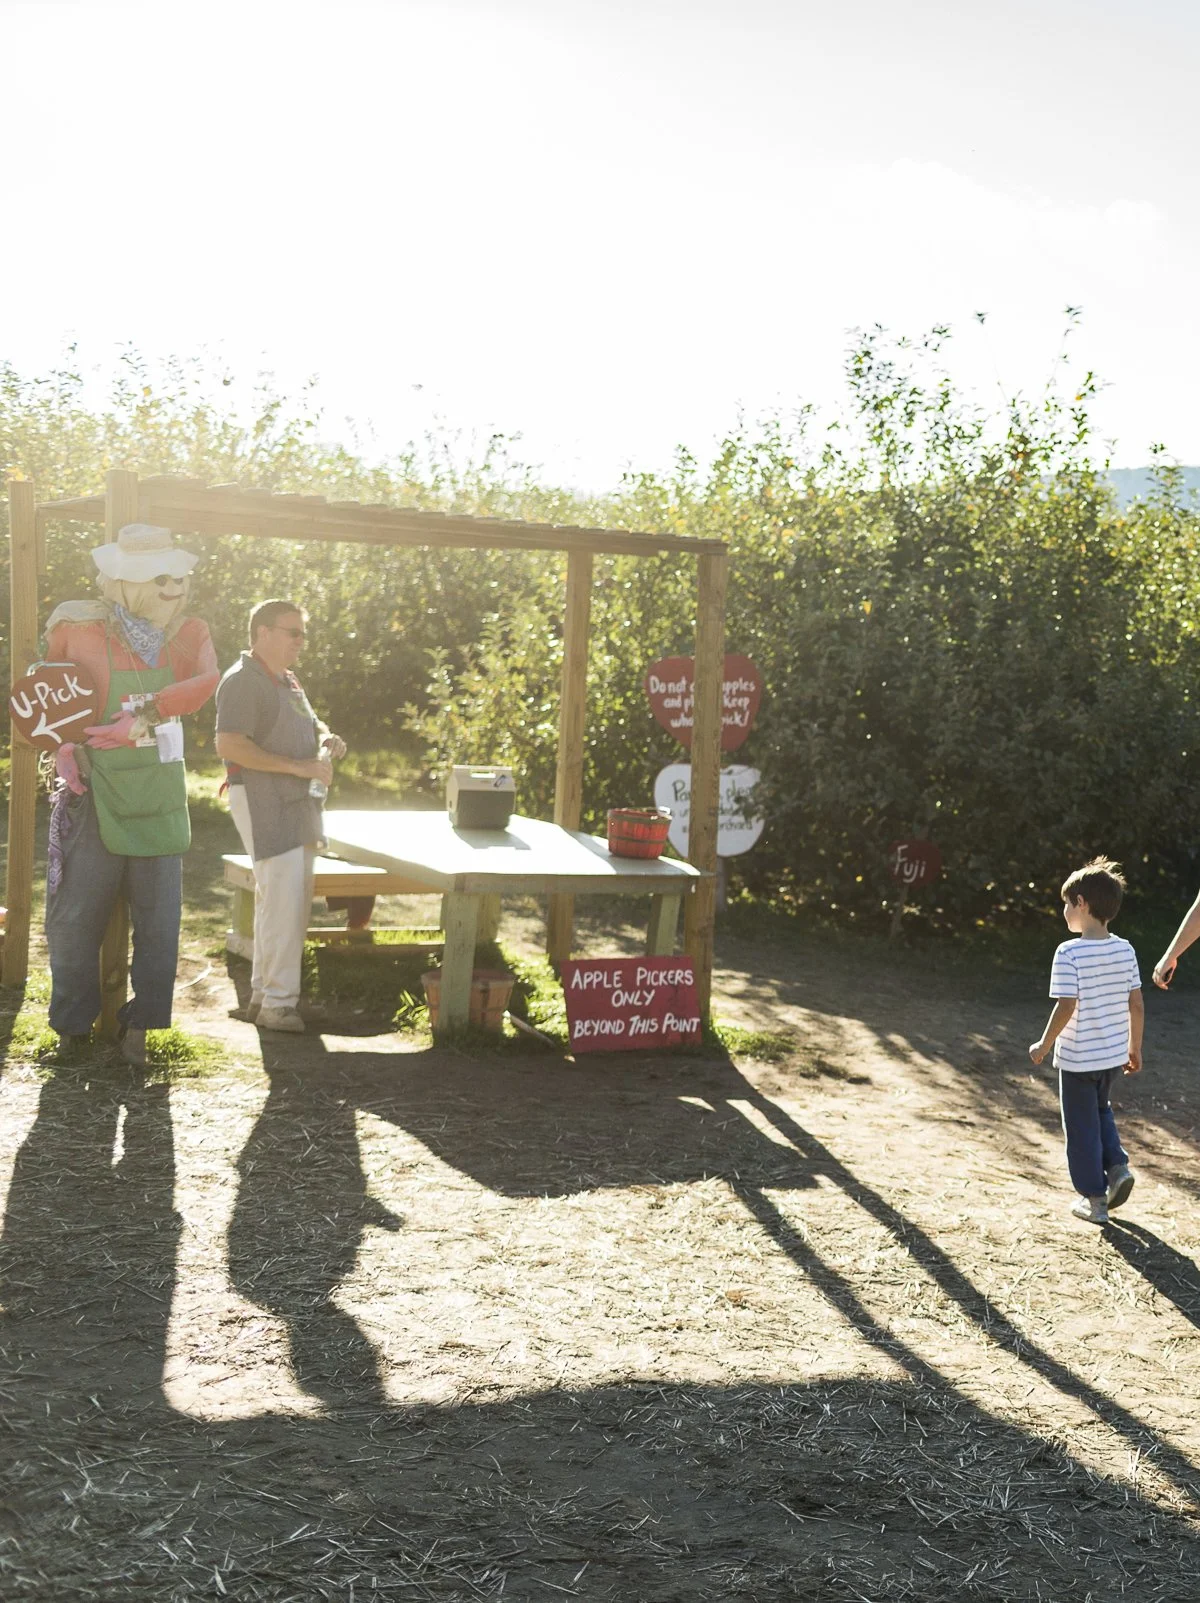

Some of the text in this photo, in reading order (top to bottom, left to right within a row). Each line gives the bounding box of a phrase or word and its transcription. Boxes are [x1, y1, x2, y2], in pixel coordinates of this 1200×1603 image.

[11, 672, 93, 718] U-Pick
[649, 675, 666, 694] Do
[667, 676, 686, 694] not
[663, 695, 682, 709] and
[670, 713, 694, 728] wha
[893, 844, 927, 883] Fuji
[571, 966, 694, 990] APPLE PICKERS
[611, 989, 656, 1008] ONLY
[573, 1019, 625, 1039] BEYOND
[628, 1015, 659, 1037] THIS
